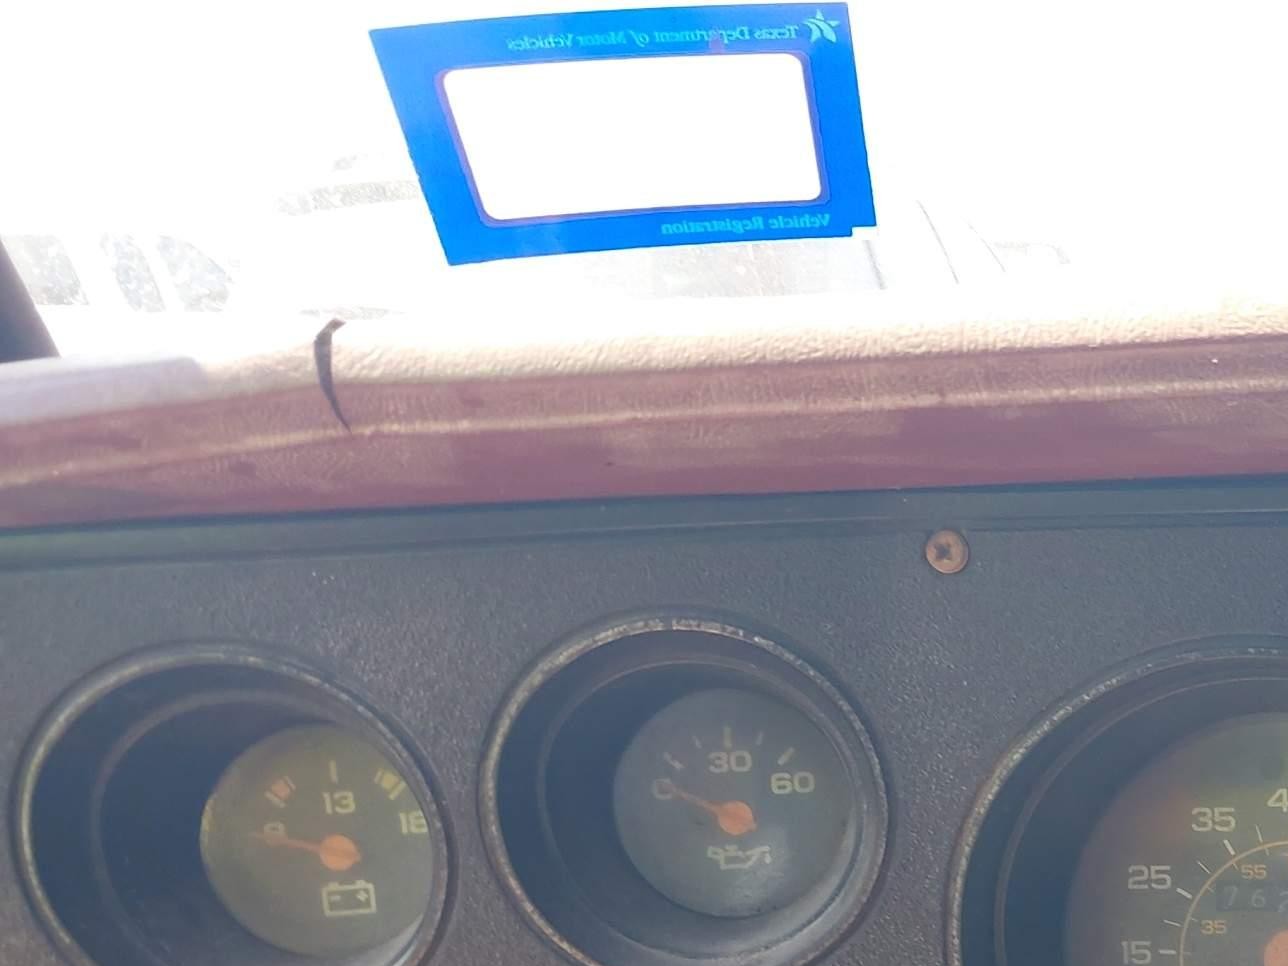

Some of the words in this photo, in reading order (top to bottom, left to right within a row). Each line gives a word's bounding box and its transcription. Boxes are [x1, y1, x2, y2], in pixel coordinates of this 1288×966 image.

[708, 751, 752, 773] 30
[770, 771, 815, 794] 60
[322, 791, 356, 814] 13
[1191, 808, 1235, 831] 35
[1127, 866, 1172, 890] 25
[1241, 864, 1267, 880] 55
[1201, 920, 1227, 935] 35
[1122, 941, 1152, 964] 15
